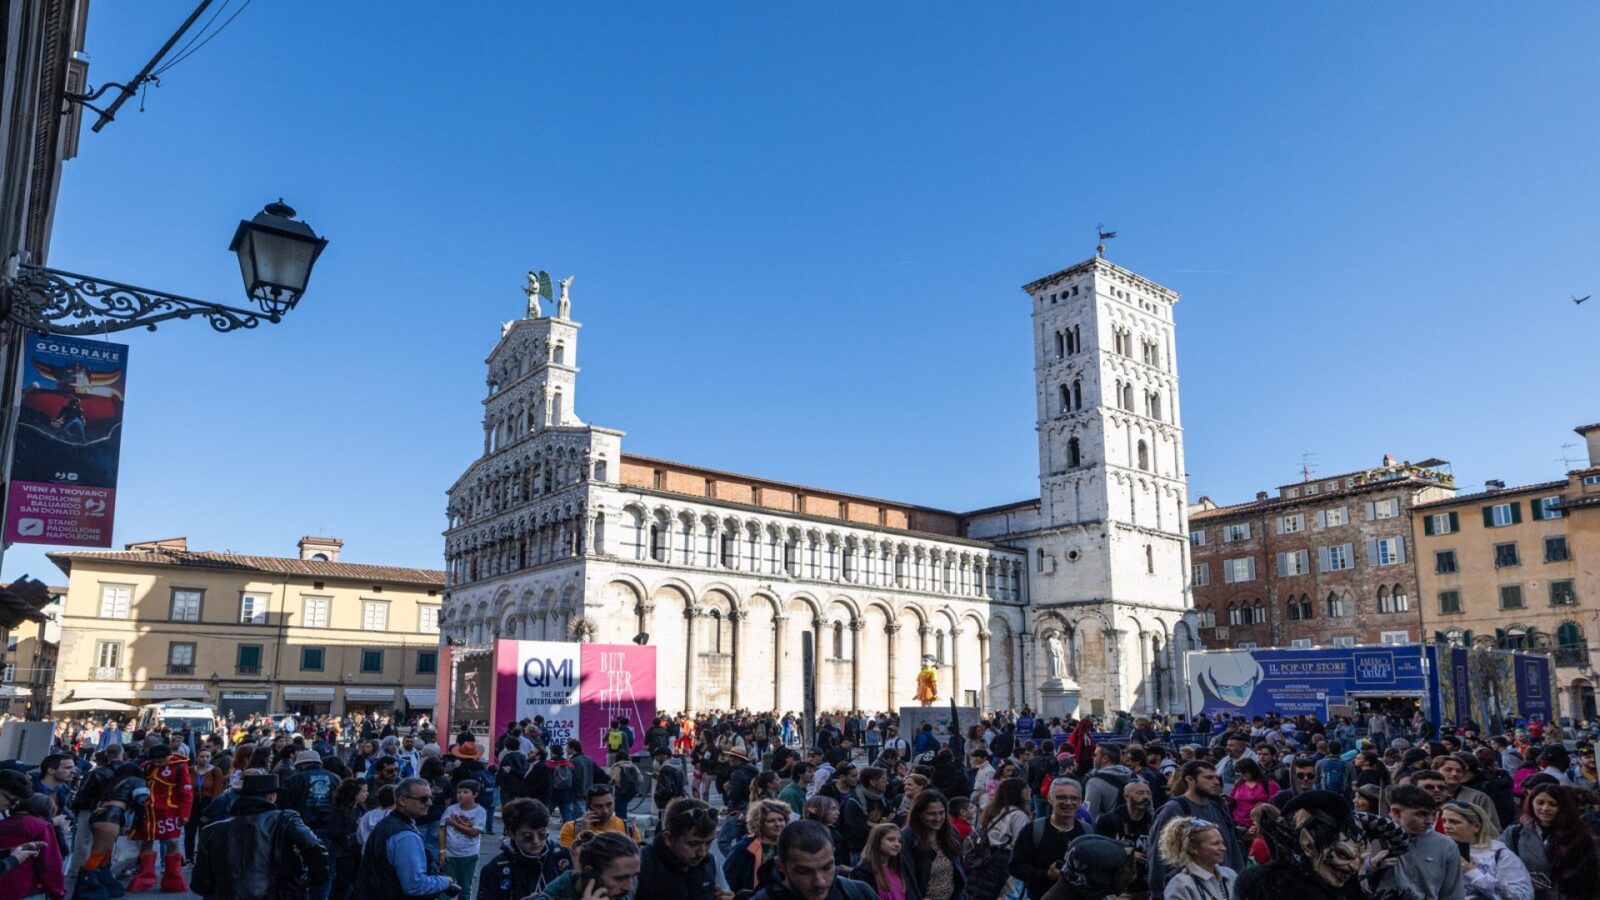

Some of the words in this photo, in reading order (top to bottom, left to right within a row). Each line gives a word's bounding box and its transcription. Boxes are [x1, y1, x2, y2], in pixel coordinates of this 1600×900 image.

[36, 342, 120, 361] GOLDRAKE
[22, 485, 48, 493] VIENI
[59, 487, 107, 497] TROVARCI
[26, 494, 81, 504] PADIGLIONE
[31, 500, 81, 510] BALUARDO
[41, 507, 81, 516] DONATO
[46, 525, 101, 534] PADIGLIONE
[46, 532, 101, 541] NAPOLEONE
[600, 652, 626, 673] BUT
[1280, 663, 1314, 671] POP-UP
[1316, 662, 1348, 671] STORE
[523, 657, 573, 687] QMI
[599, 690, 625, 710] FLY
[545, 720, 574, 729] CA24
